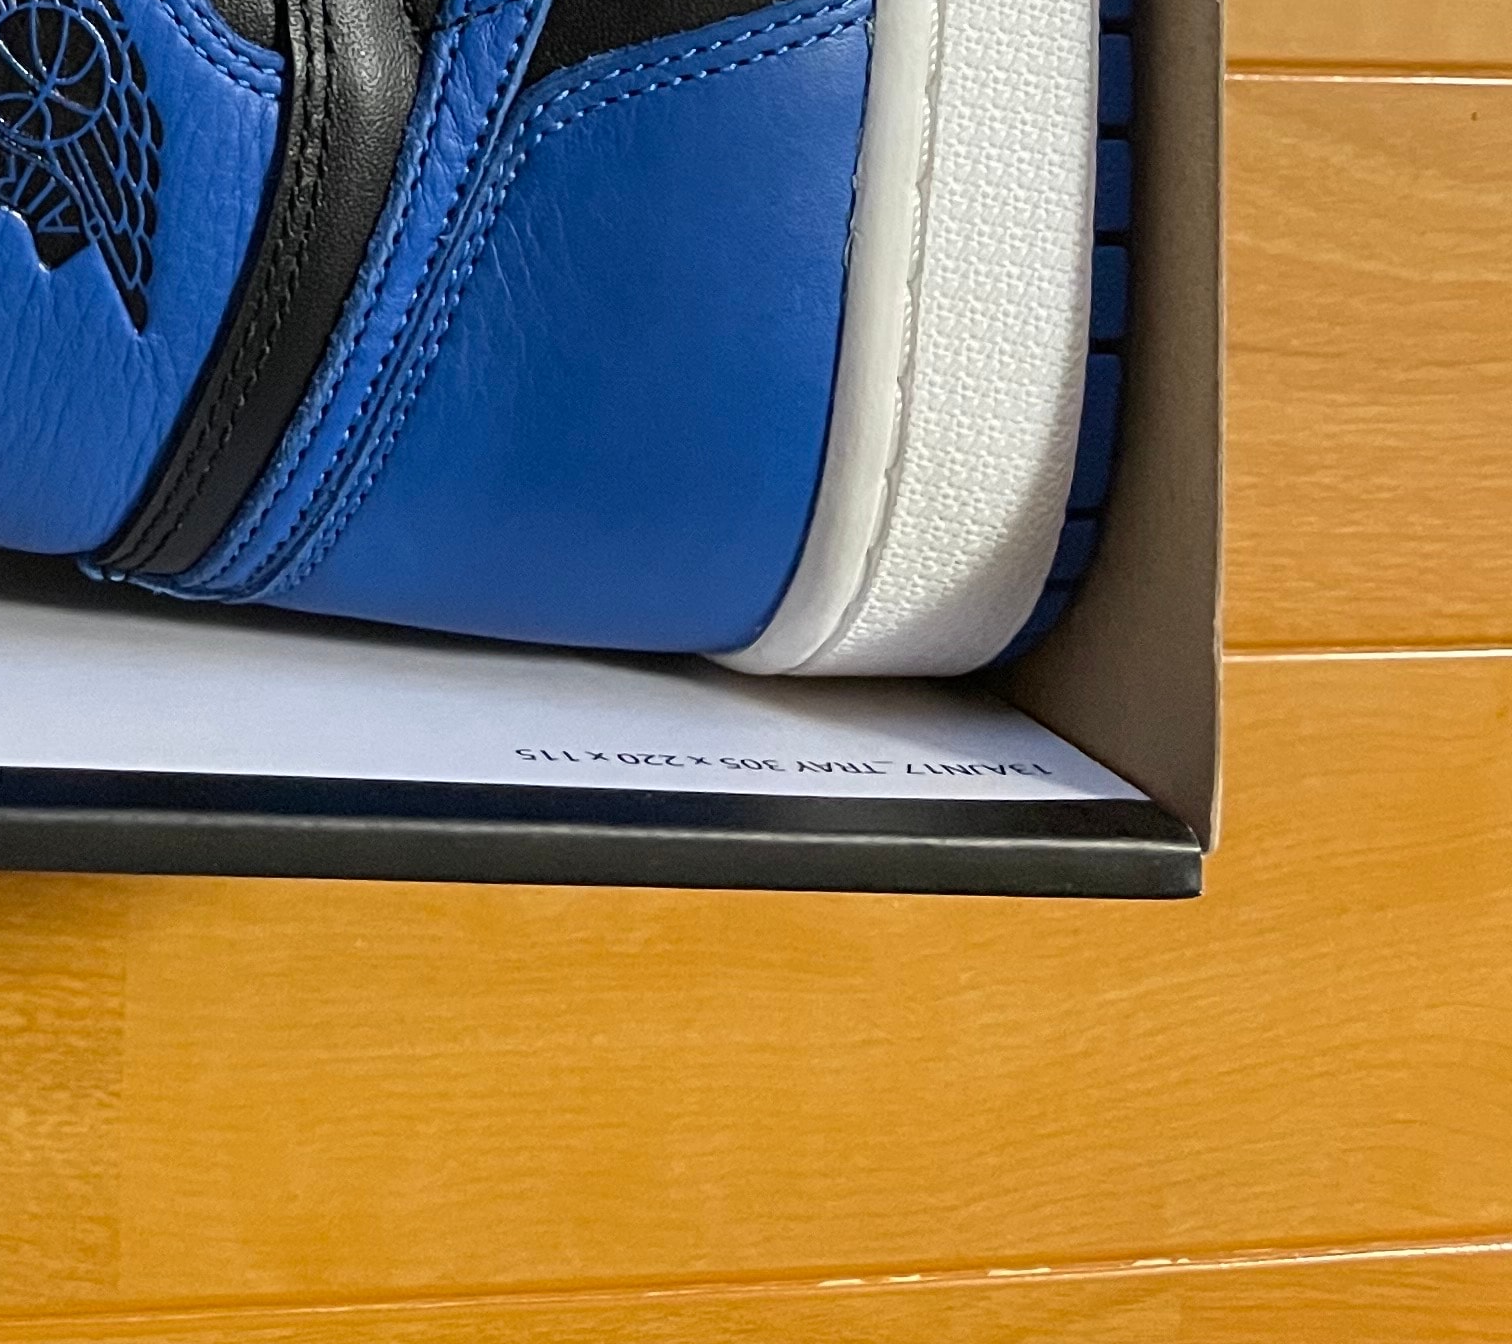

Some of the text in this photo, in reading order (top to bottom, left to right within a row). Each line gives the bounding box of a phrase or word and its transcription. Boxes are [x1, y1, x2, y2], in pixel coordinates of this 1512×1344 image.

[514, 748, 581, 763] 115
[616, 752, 685, 768] 220
[719, 757, 786, 773] 305
